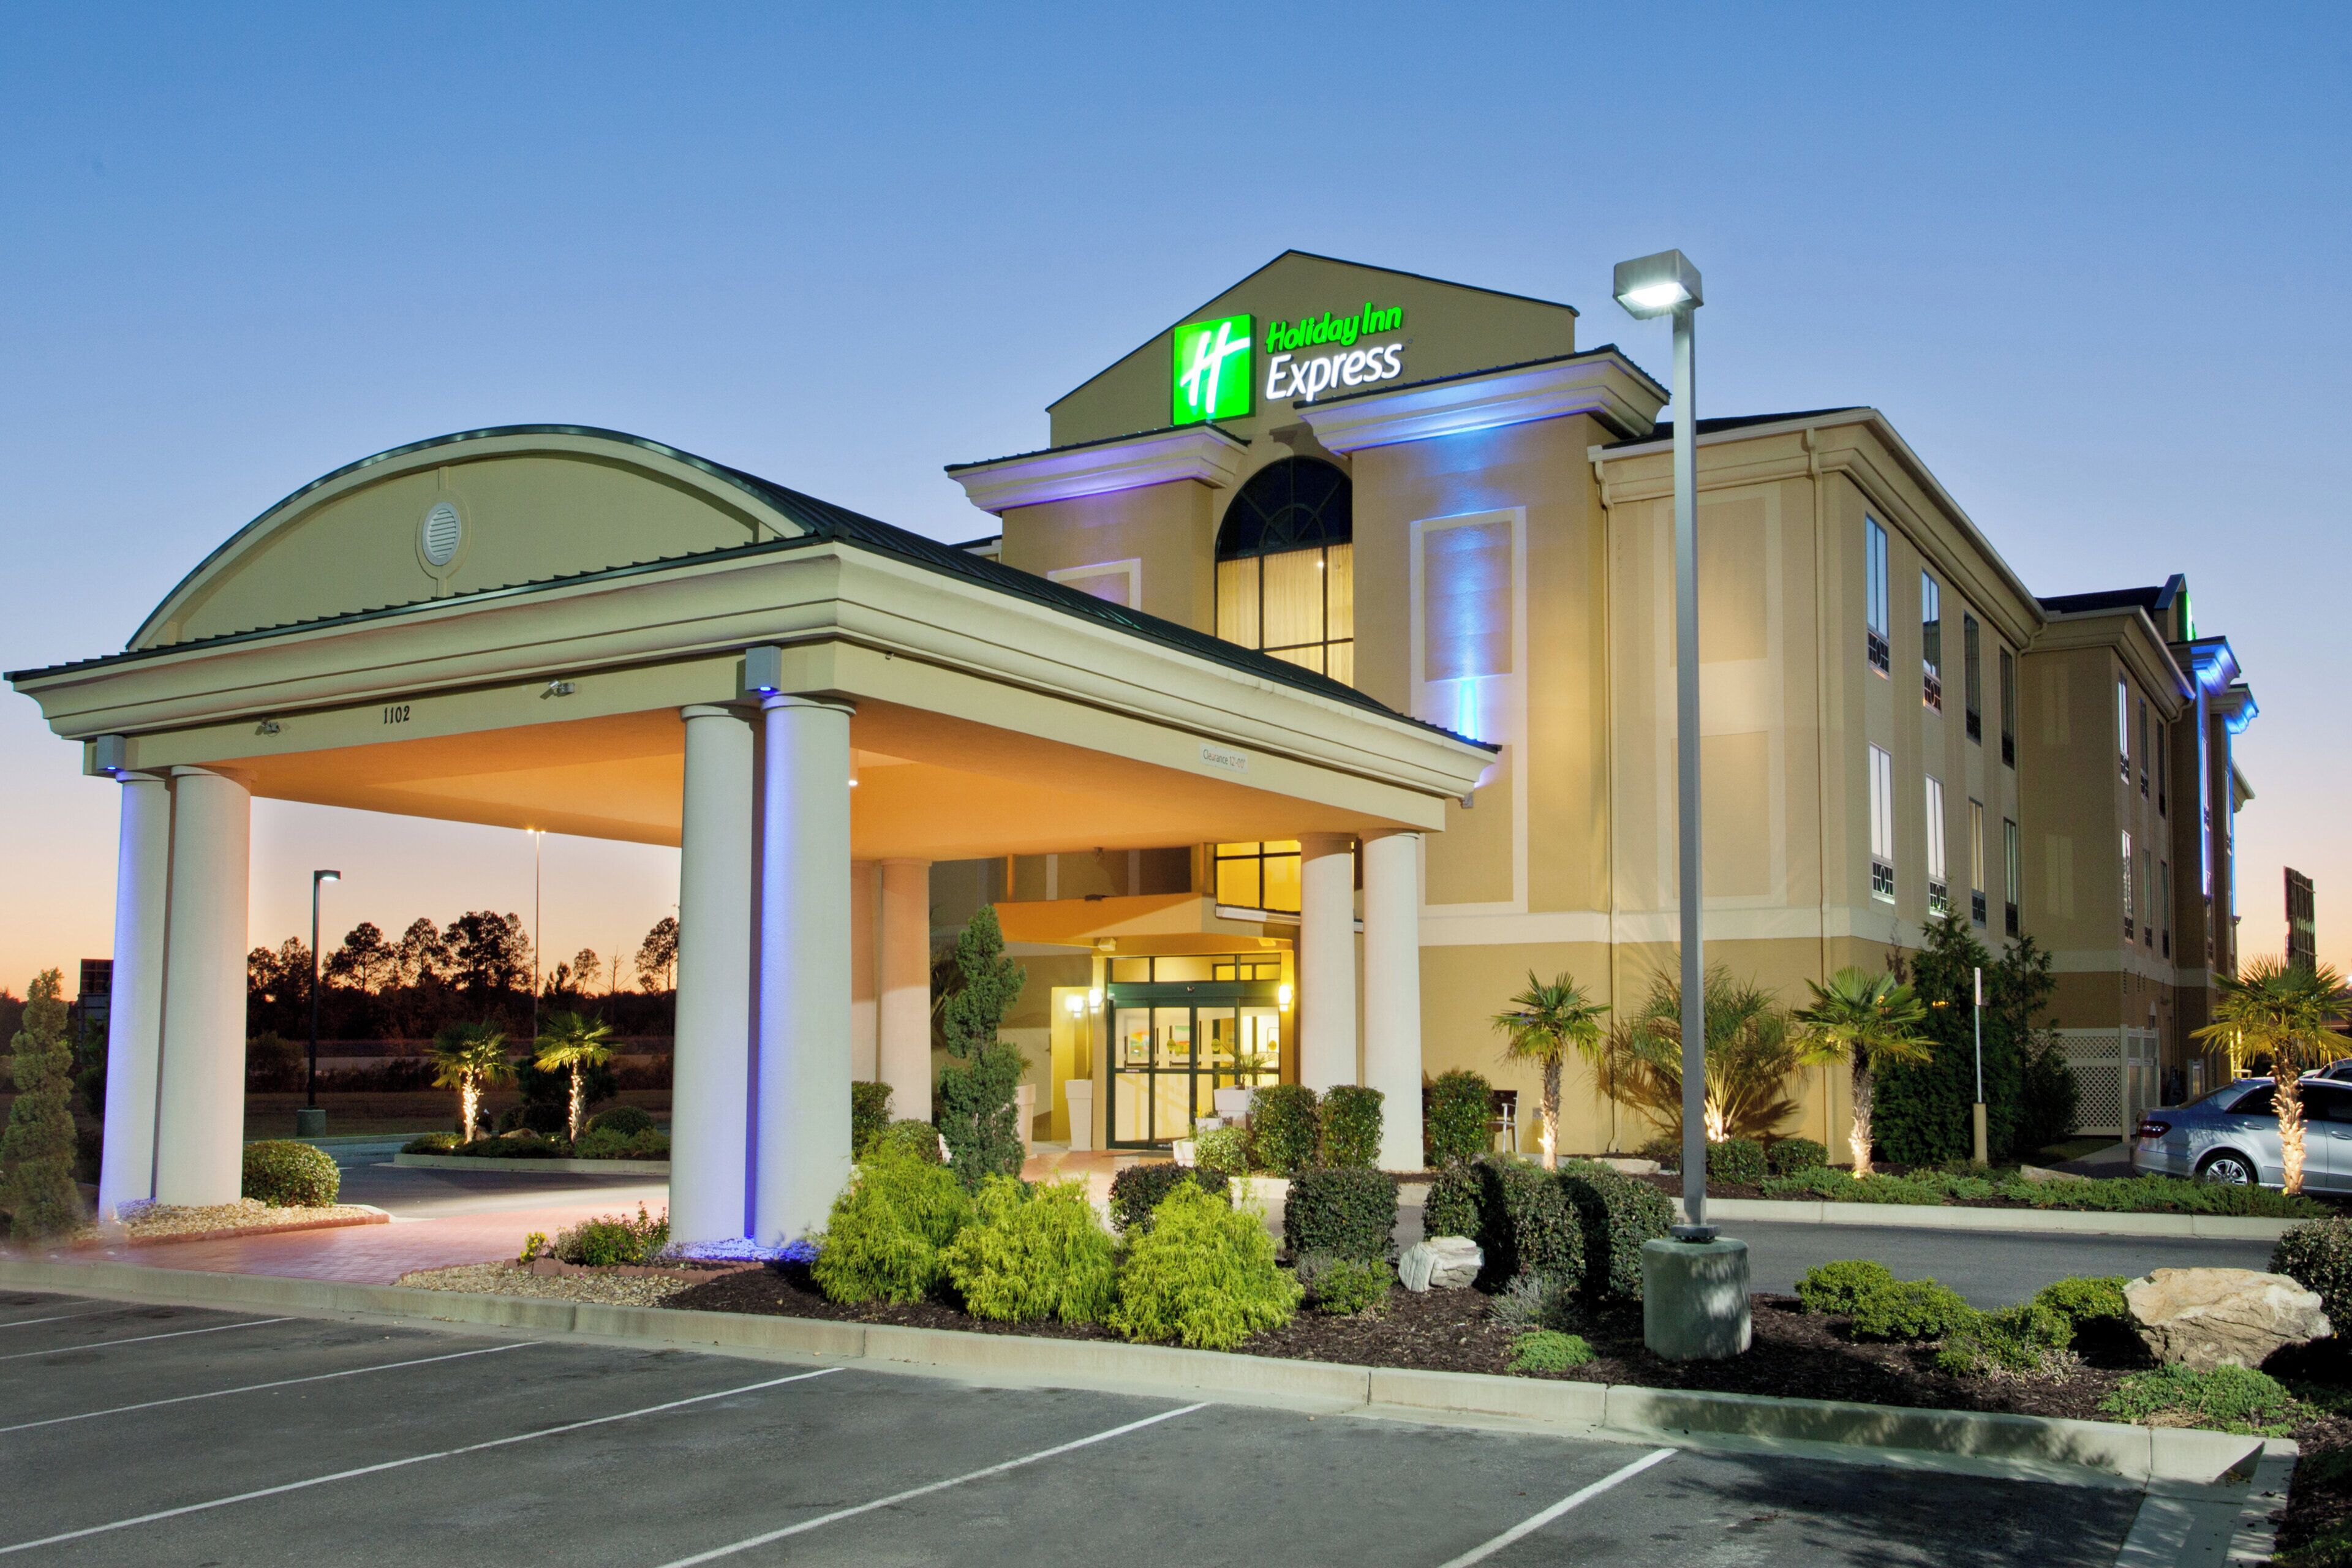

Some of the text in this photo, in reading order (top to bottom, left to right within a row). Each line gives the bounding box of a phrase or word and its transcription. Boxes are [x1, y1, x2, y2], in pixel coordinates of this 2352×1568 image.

[1265, 302, 1403, 353] Holiday Inn
[1180, 322, 1250, 414] H
[1265, 343, 1403, 402] Express
[383, 705, 410, 725] 1102
[1203, 749, 1229, 765] Clearance
